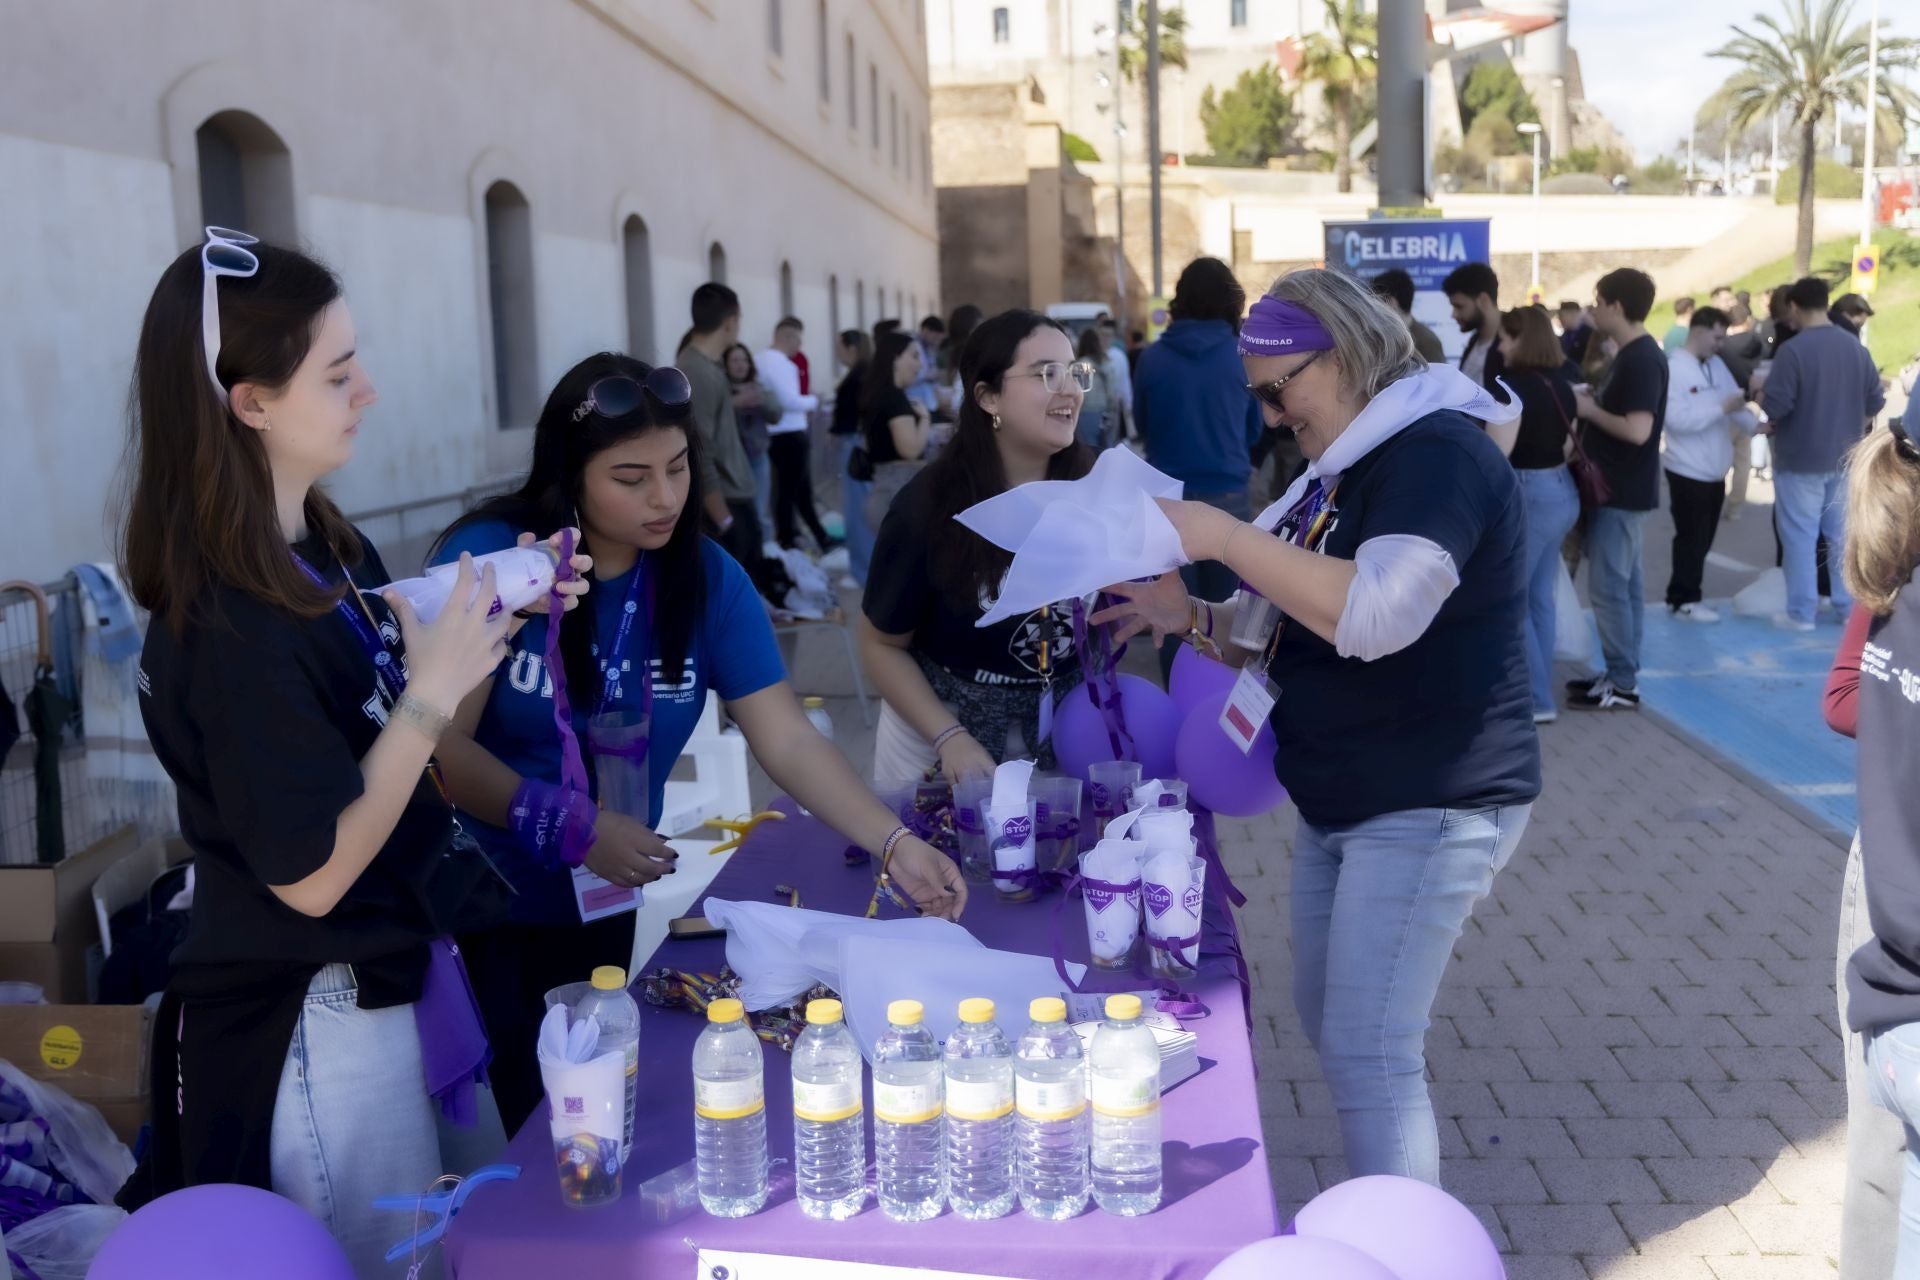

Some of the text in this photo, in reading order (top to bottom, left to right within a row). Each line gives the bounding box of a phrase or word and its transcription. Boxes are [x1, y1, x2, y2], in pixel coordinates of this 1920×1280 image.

[1246, 335, 1293, 346] DIVERSIDAD
[1006, 824, 1030, 834] STOP
[1145, 892, 1170, 903] STOP
[1185, 893, 1201, 904] STO
